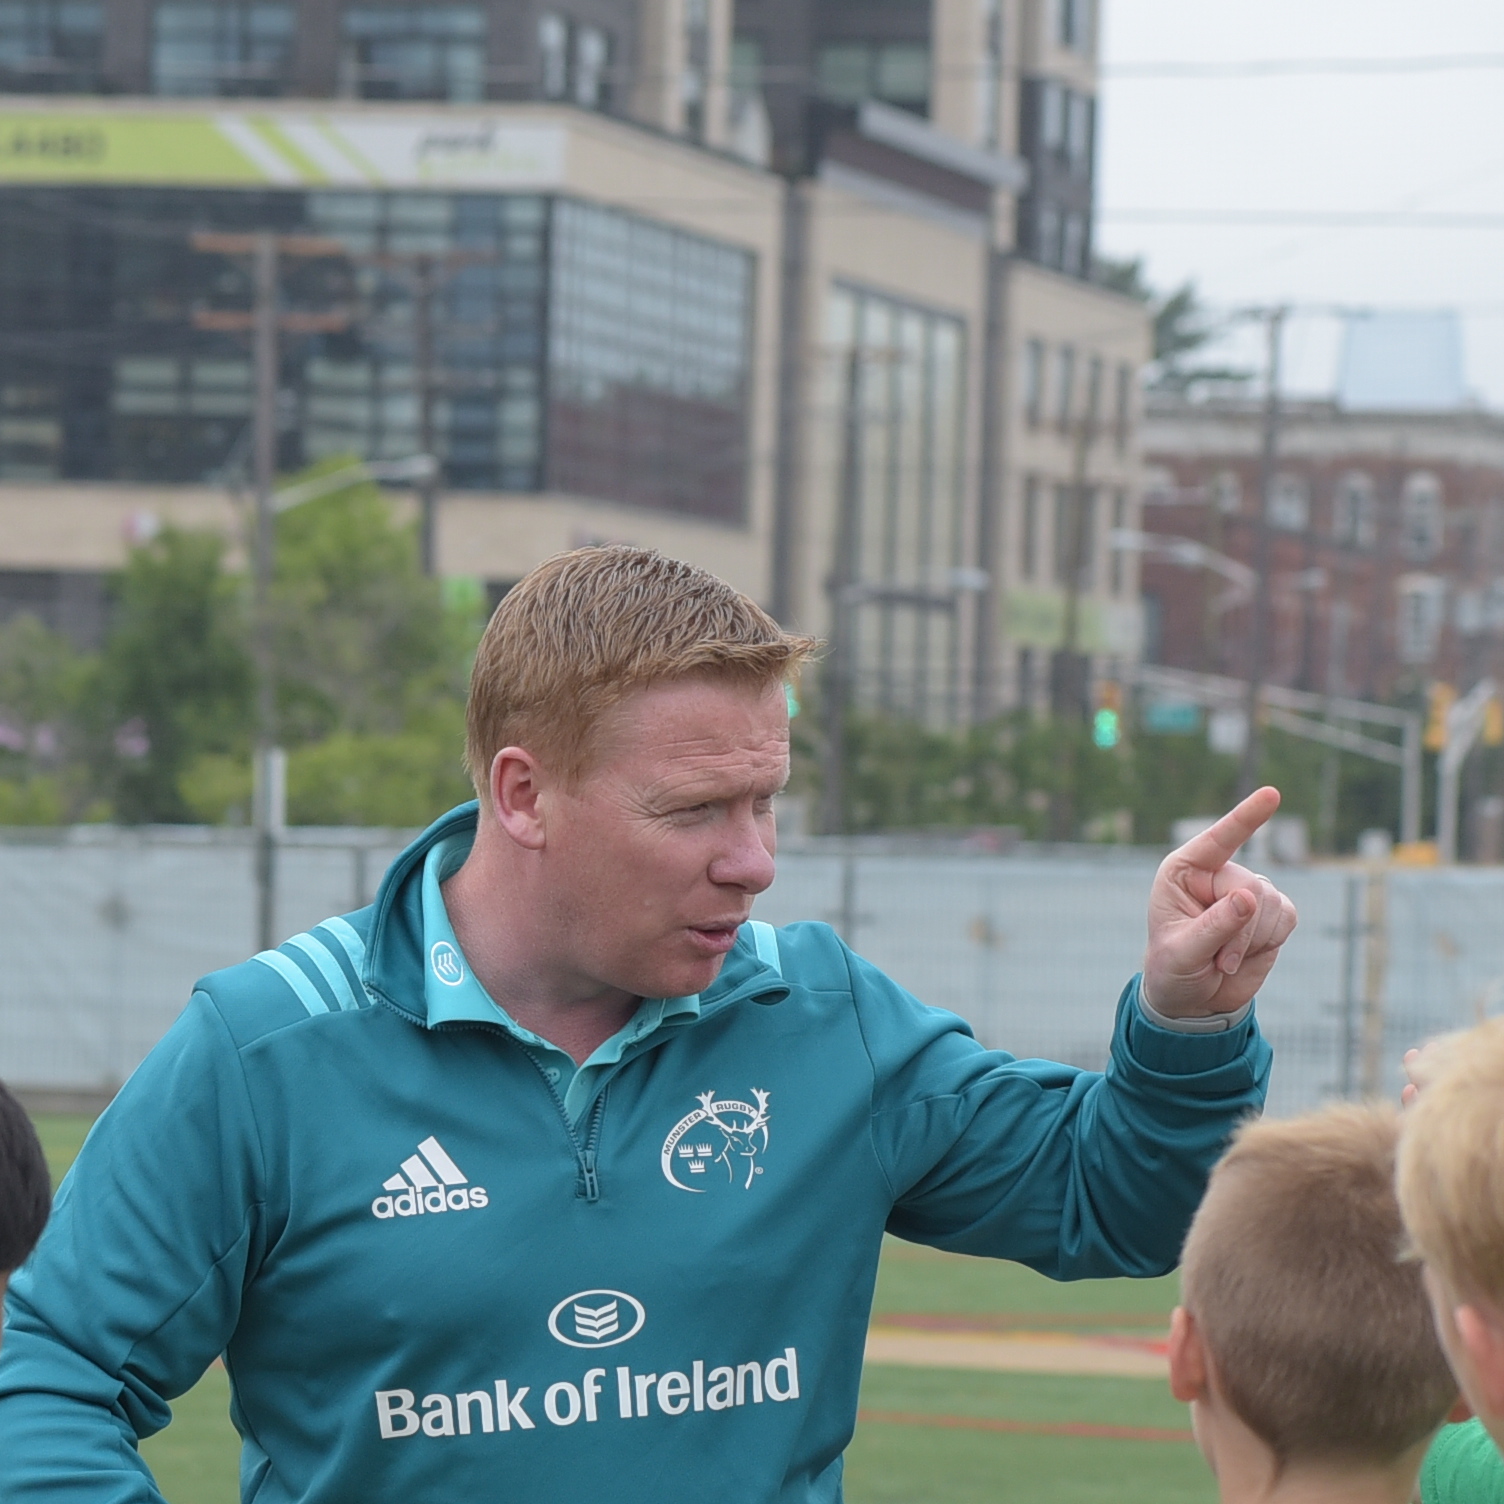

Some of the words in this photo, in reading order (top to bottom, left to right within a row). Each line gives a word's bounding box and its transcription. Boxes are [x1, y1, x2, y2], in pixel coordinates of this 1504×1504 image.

[664, 1111, 702, 1156] MUNSTER
[715, 1102, 755, 1116] RUGBY
[372, 1184, 488, 1219] adidas
[375, 1379, 535, 1440] Bank
[544, 1367, 605, 1426] of
[616, 1347, 800, 1418] Ireland
